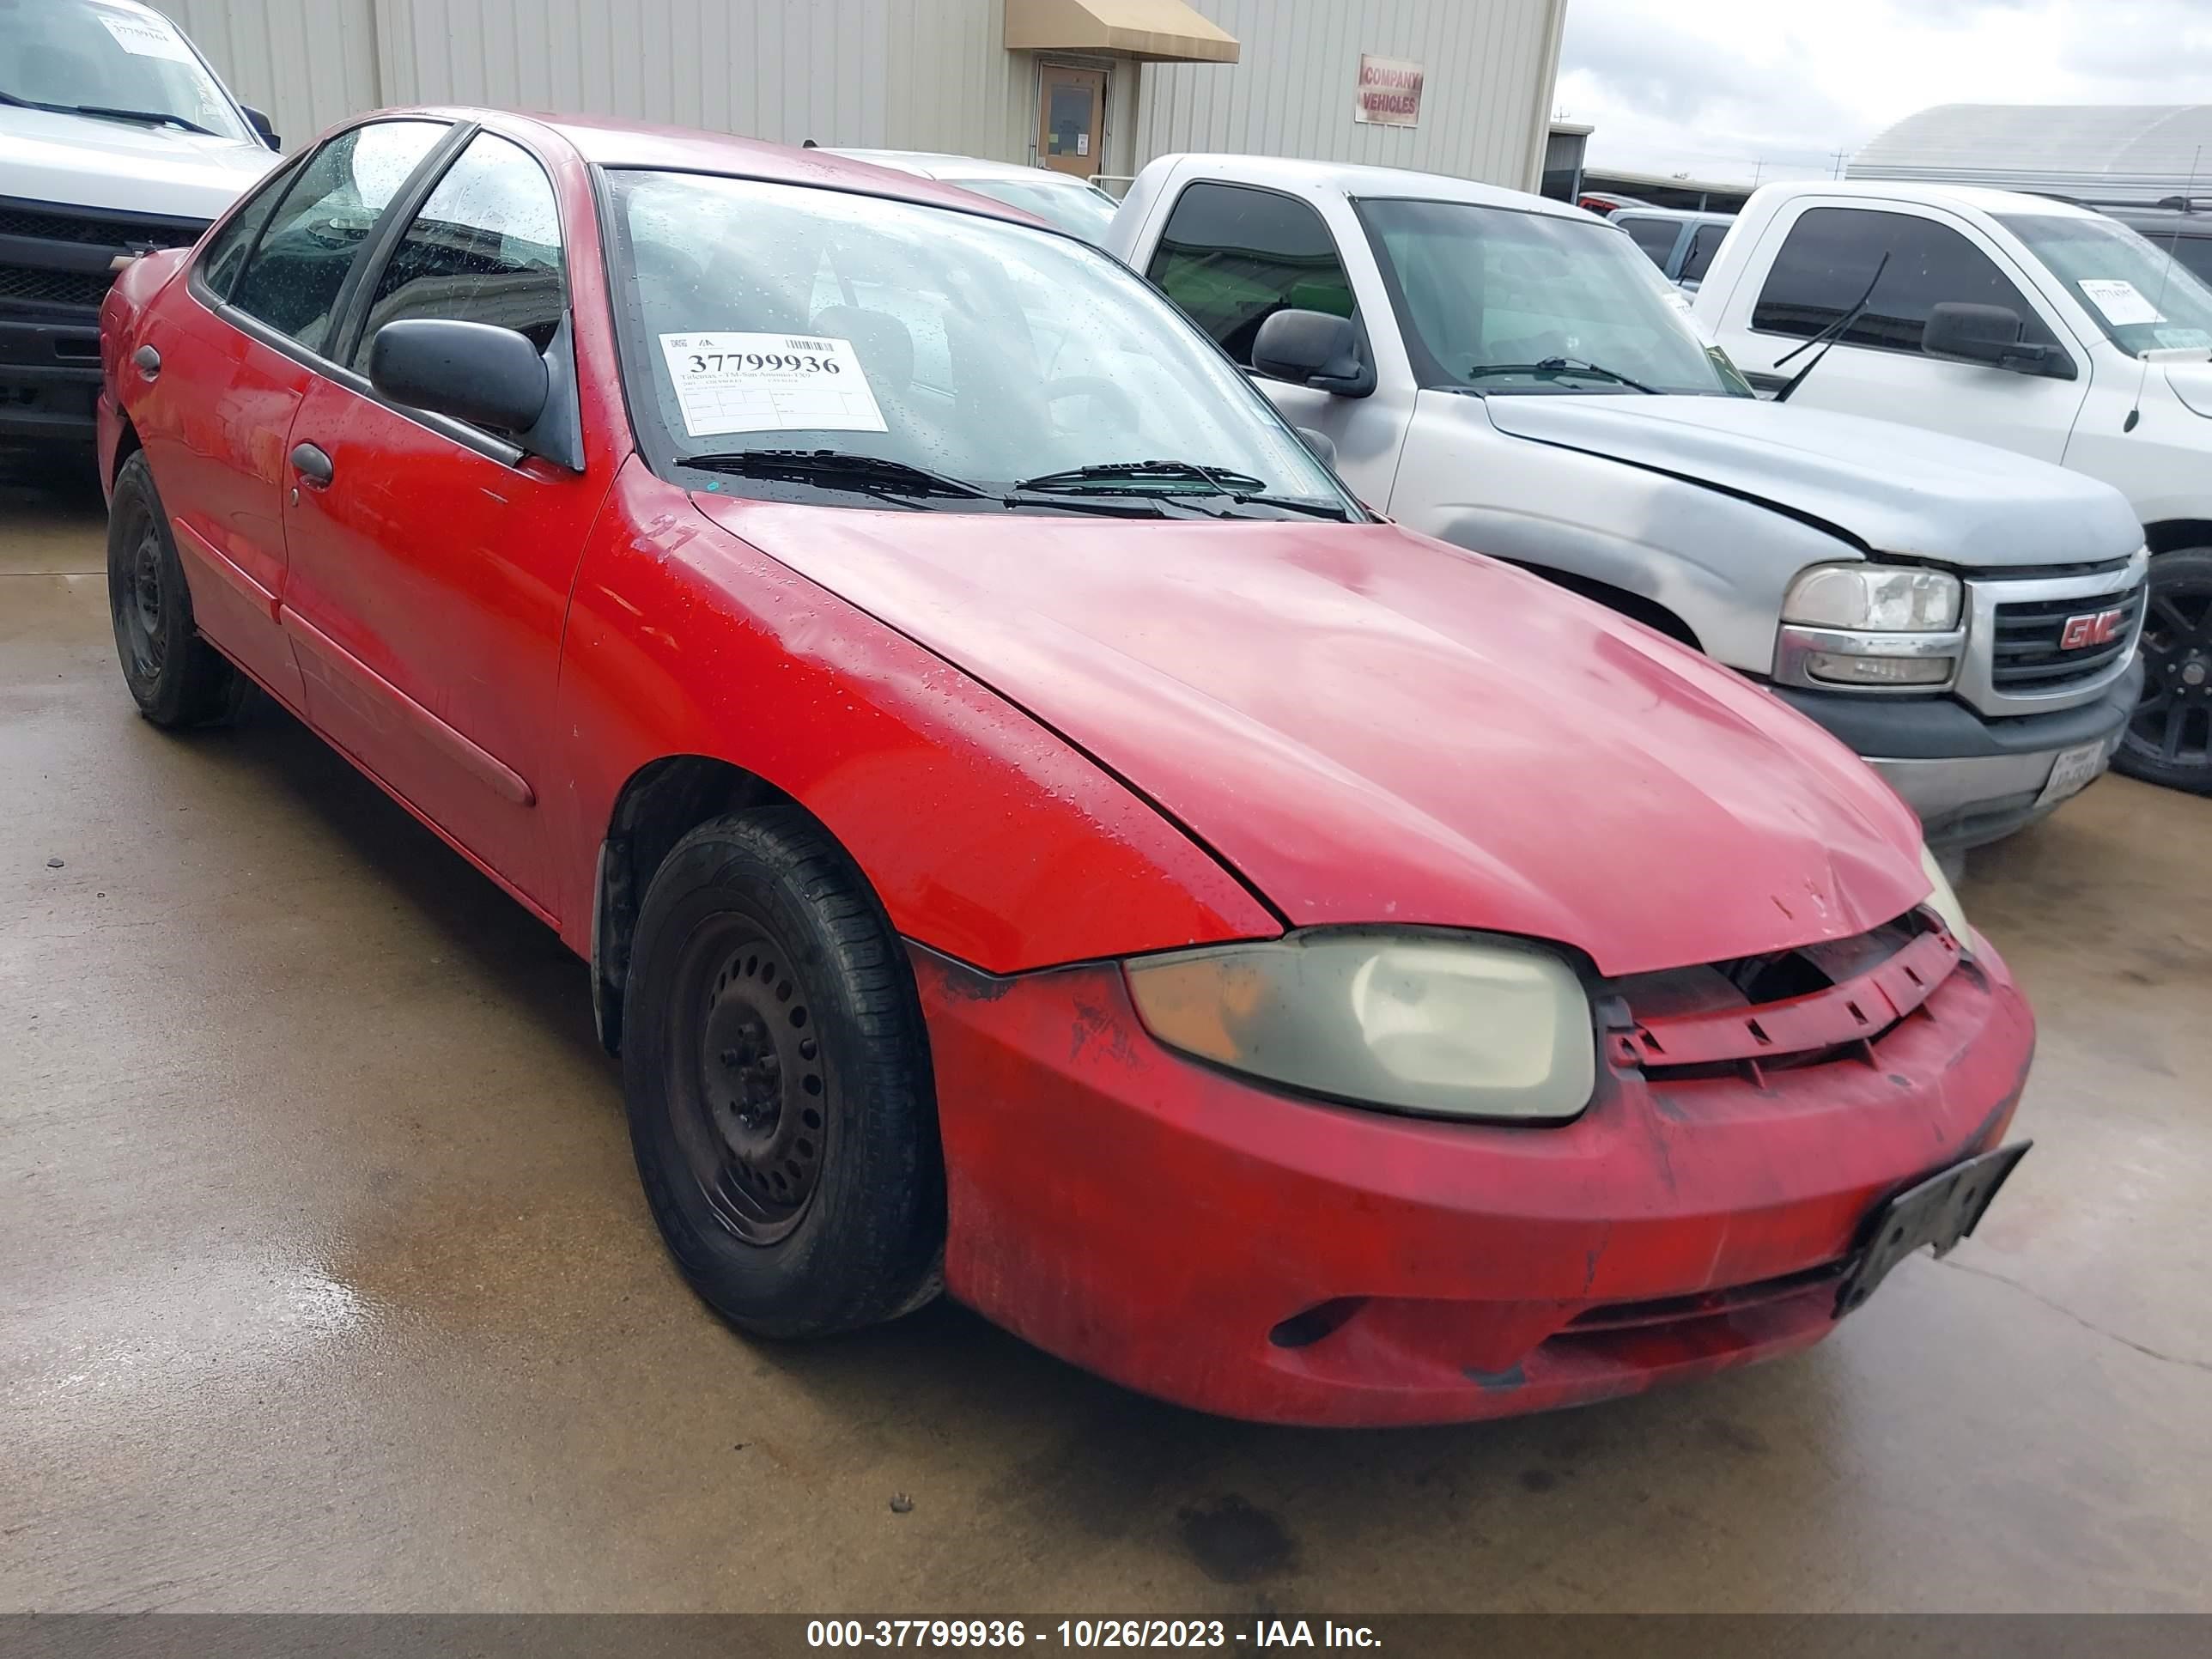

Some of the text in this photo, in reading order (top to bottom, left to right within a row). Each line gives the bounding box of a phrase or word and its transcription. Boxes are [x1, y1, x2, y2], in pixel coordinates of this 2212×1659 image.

[1365, 67, 1419, 89] COMPANY
[1364, 92, 1416, 114] VEHICLES
[689, 353, 841, 374] 37799936
[2061, 609, 2122, 650] GMC
